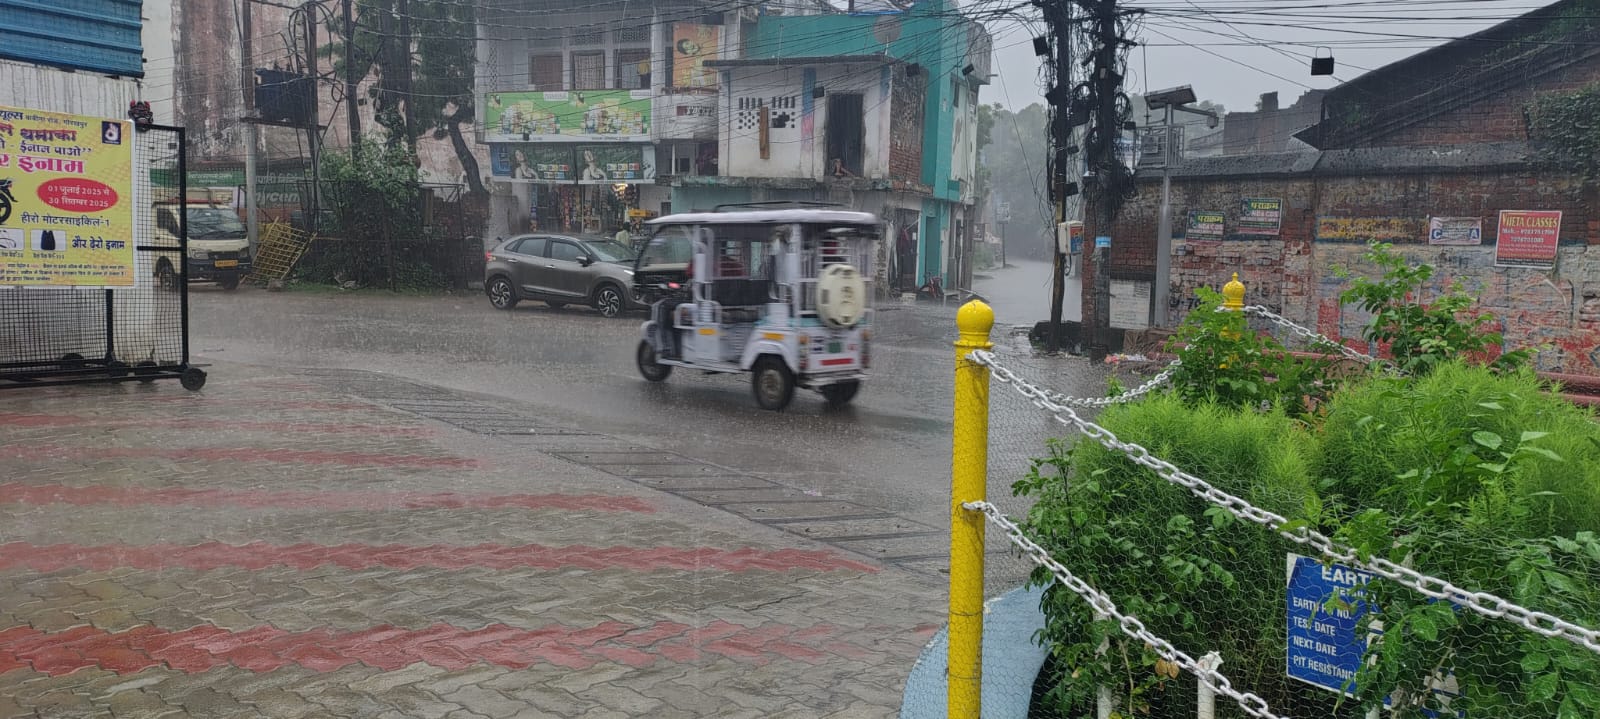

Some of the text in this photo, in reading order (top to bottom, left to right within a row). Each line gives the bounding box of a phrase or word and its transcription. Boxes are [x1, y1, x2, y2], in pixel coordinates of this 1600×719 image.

[17, 155, 84, 174] इनाम
[48, 184, 58, 193] 01
[60, 184, 81, 196] जुलाई
[82, 187, 101, 196] 2025
[48, 196, 59, 205] 30
[89, 199, 109, 208] 2025
[21, 211, 39, 225] हीरो
[1526, 216, 1558, 228] CLASSES
[72, 235, 87, 249] और
[105, 239, 126, 251] इनाम
[1321, 565, 1381, 586] EART
[1314, 621, 1336, 636] DATE
[1292, 635, 1337, 656] NEXT DATE
[1292, 655, 1357, 682] PIT RESISTANC
